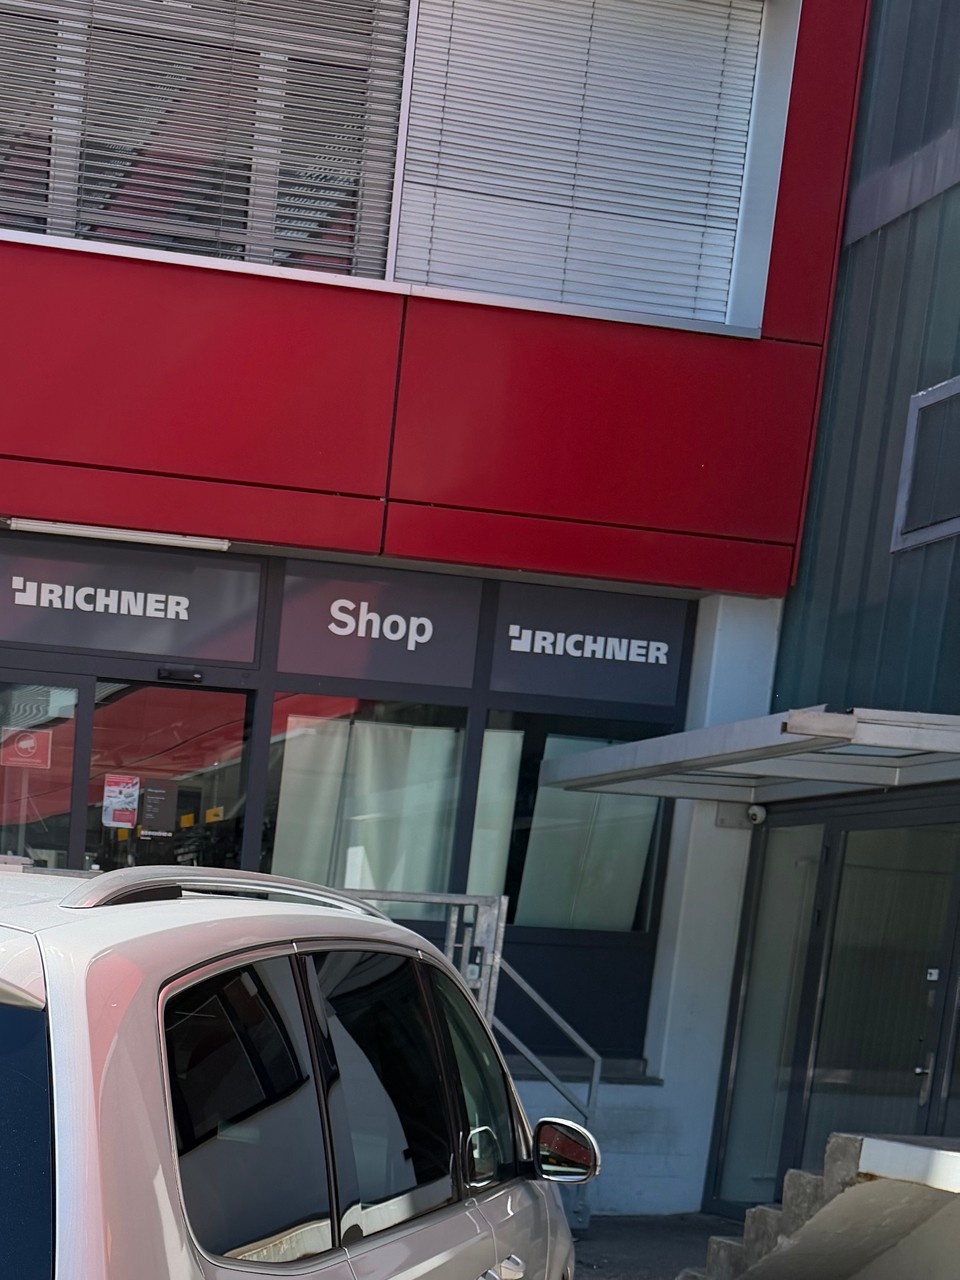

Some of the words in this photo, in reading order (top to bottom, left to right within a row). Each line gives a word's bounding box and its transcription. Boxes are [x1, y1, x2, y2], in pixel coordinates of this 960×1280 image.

[39, 583, 190, 620] RICHNER
[328, 598, 433, 651] Shop
[533, 632, 669, 665] RICHNER
